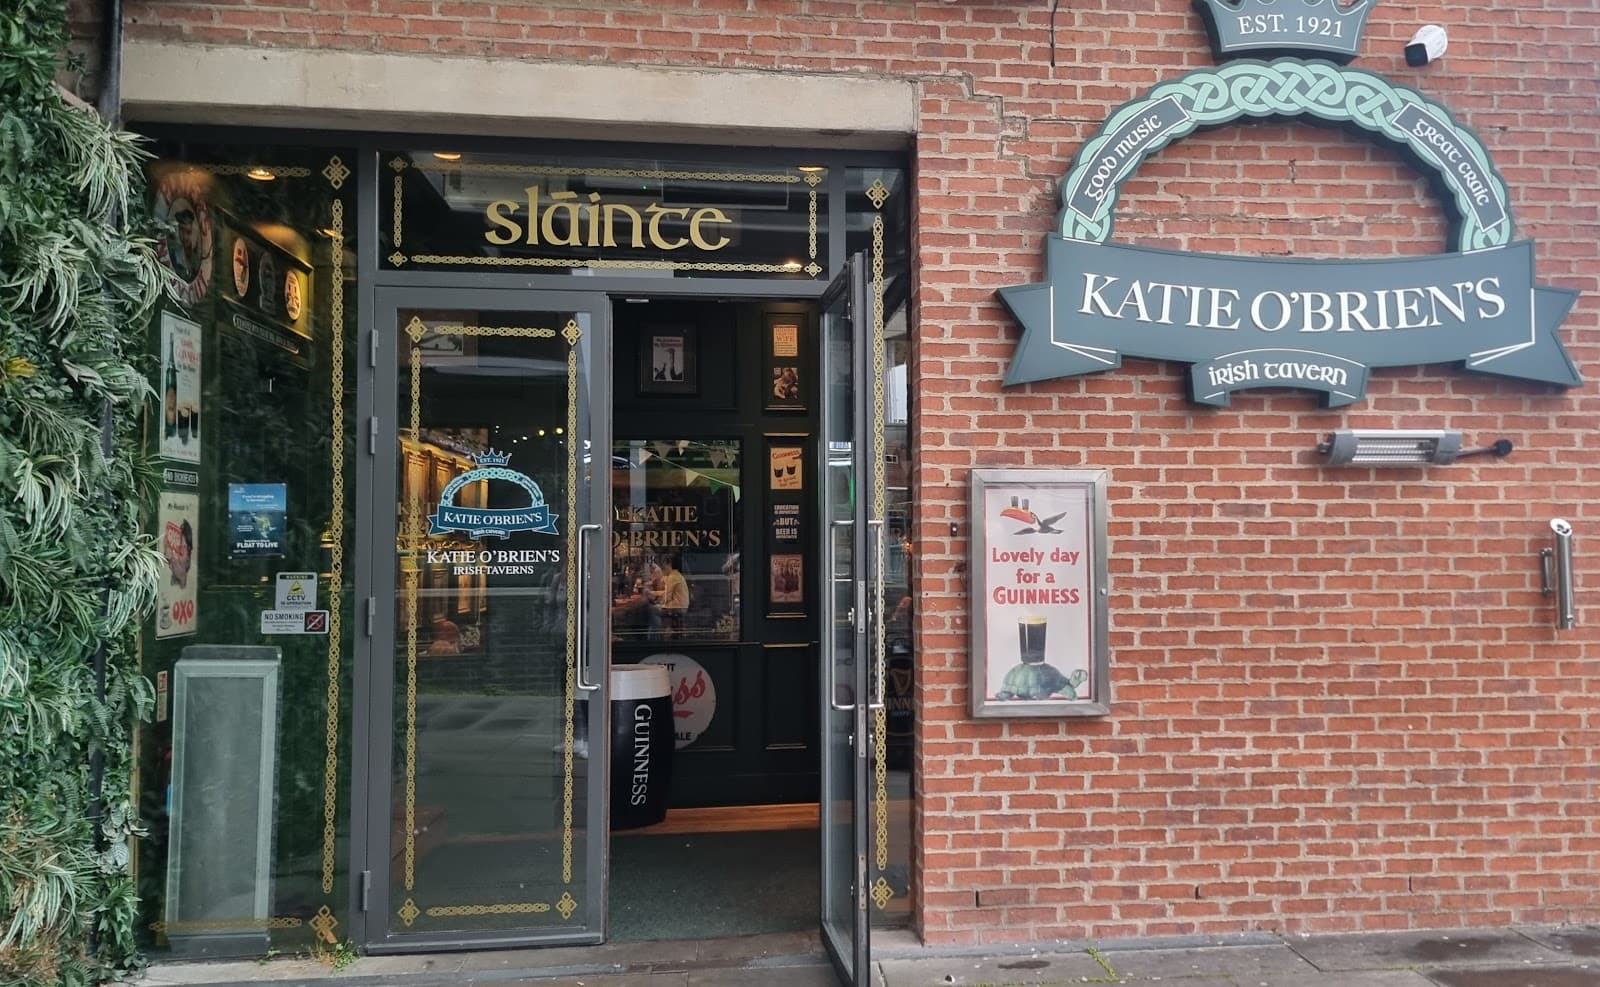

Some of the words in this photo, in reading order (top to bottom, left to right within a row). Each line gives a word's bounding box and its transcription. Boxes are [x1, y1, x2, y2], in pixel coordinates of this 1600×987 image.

[1238, 14, 1288, 34] EST.
[1295, 16, 1343, 38] 1921
[1078, 272, 1241, 330] KATIE
[1250, 277, 1507, 333] O'BRIEN'S
[444, 511, 482, 524] KATIE
[483, 512, 543, 526] O'BRIEN'S
[627, 505, 698, 523] KATIE
[427, 550, 475, 564] KATIE
[480, 550, 560, 563] O'BRIEN'S
[992, 547, 1045, 566] Lovely
[1050, 547, 1080, 566] day
[453, 566, 482, 575] IRISH
[484, 566, 534, 575] TAVERNS
[1016, 568, 1041, 584] for
[1046, 572, 1056, 584] a
[993, 586, 1080, 605] GUINNESS
[173, 599, 194, 625] OXO
[630, 704, 653, 806] GUINNESS
